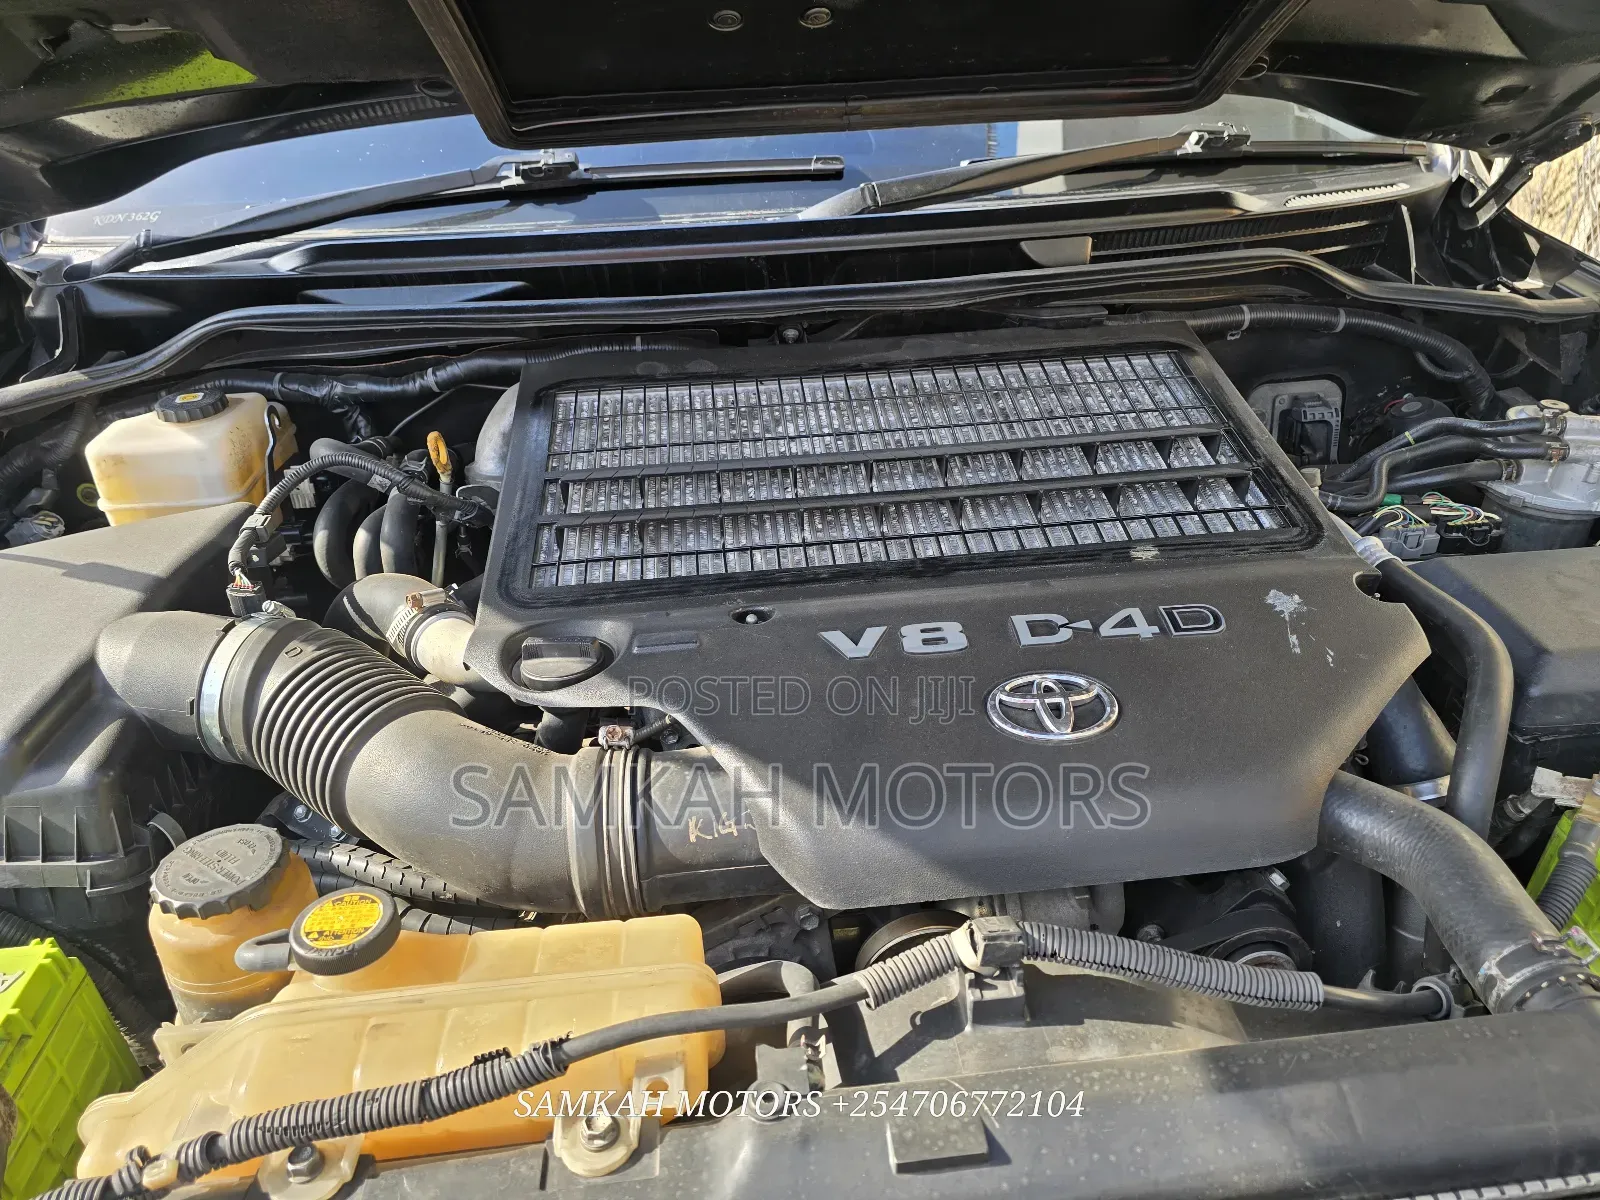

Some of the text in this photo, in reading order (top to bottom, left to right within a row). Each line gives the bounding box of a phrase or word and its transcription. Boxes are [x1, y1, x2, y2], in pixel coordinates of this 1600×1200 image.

[127, 210, 162, 223] 362G
[818, 621, 969, 660] V8
[182, 845, 221, 870] STEERING
[215, 849, 240, 865] FLUID
[219, 865, 246, 887] POWER
